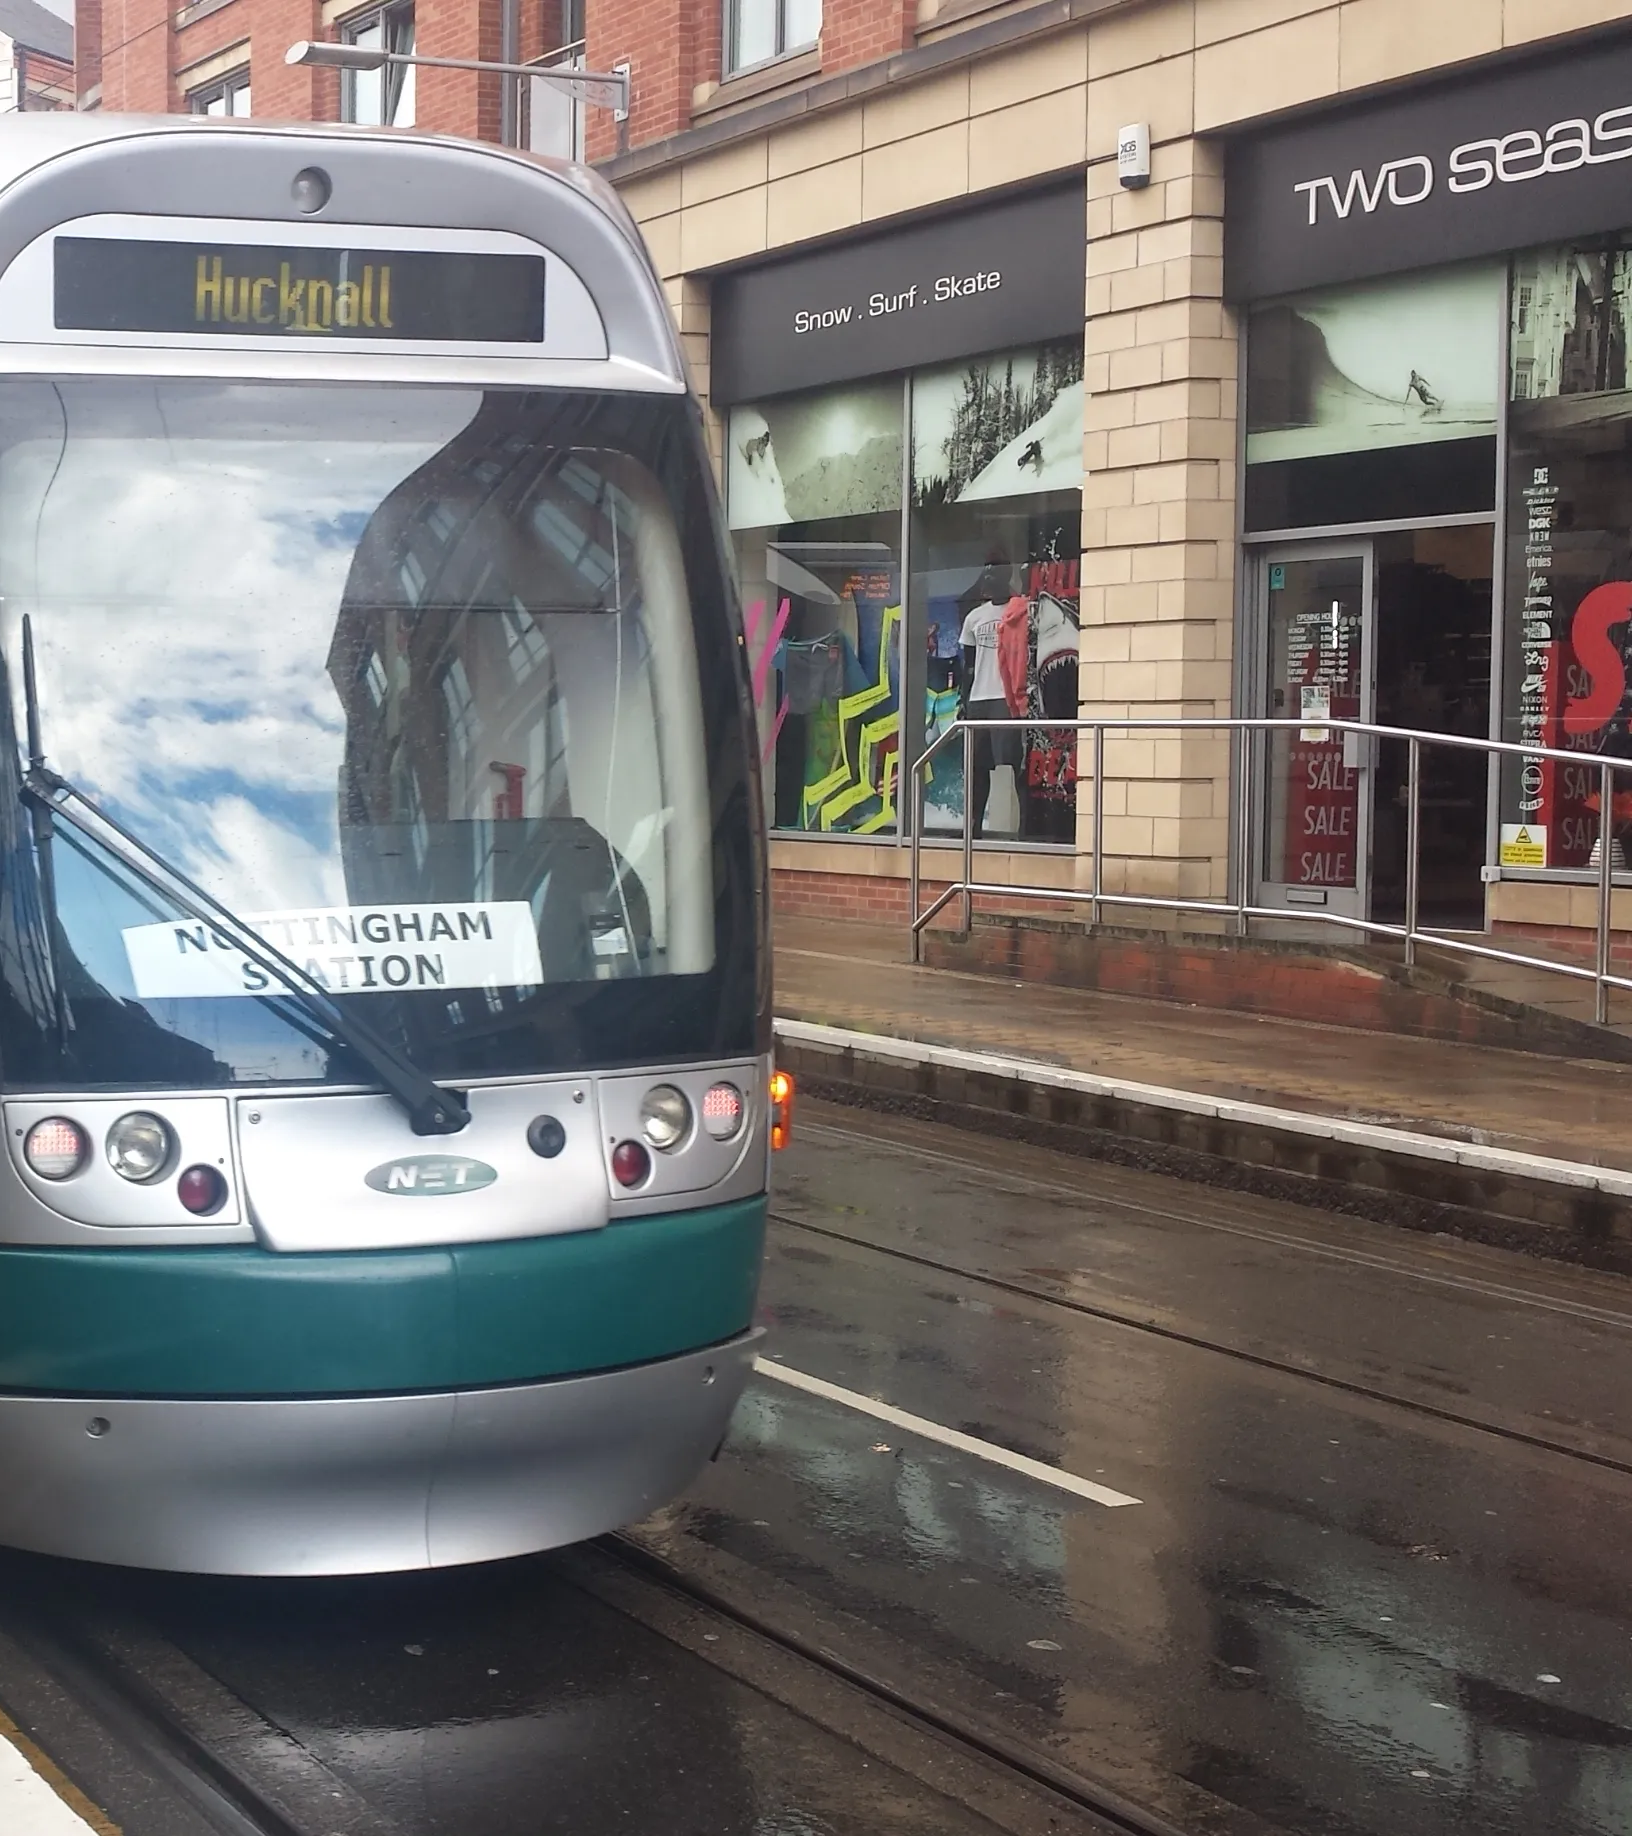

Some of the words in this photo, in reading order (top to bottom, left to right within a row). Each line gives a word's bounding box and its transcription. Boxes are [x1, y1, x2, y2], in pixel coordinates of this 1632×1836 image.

[1294, 155, 1434, 225] TWO
[195, 255, 395, 331] Hucknall
[794, 306, 853, 334] Snow
[869, 284, 917, 317] Surf
[934, 271, 1002, 302] Skate
[1526, 555, 1552, 568] etnies
[1523, 696, 1547, 704] NIXON
[1306, 760, 1354, 791] SALE
[1304, 805, 1352, 836] SALE
[1300, 852, 1347, 882] SALE
[174, 910, 493, 954] NOTTINGHAM
[241, 953, 446, 991] STATION
[388, 1163, 475, 1189] NET
